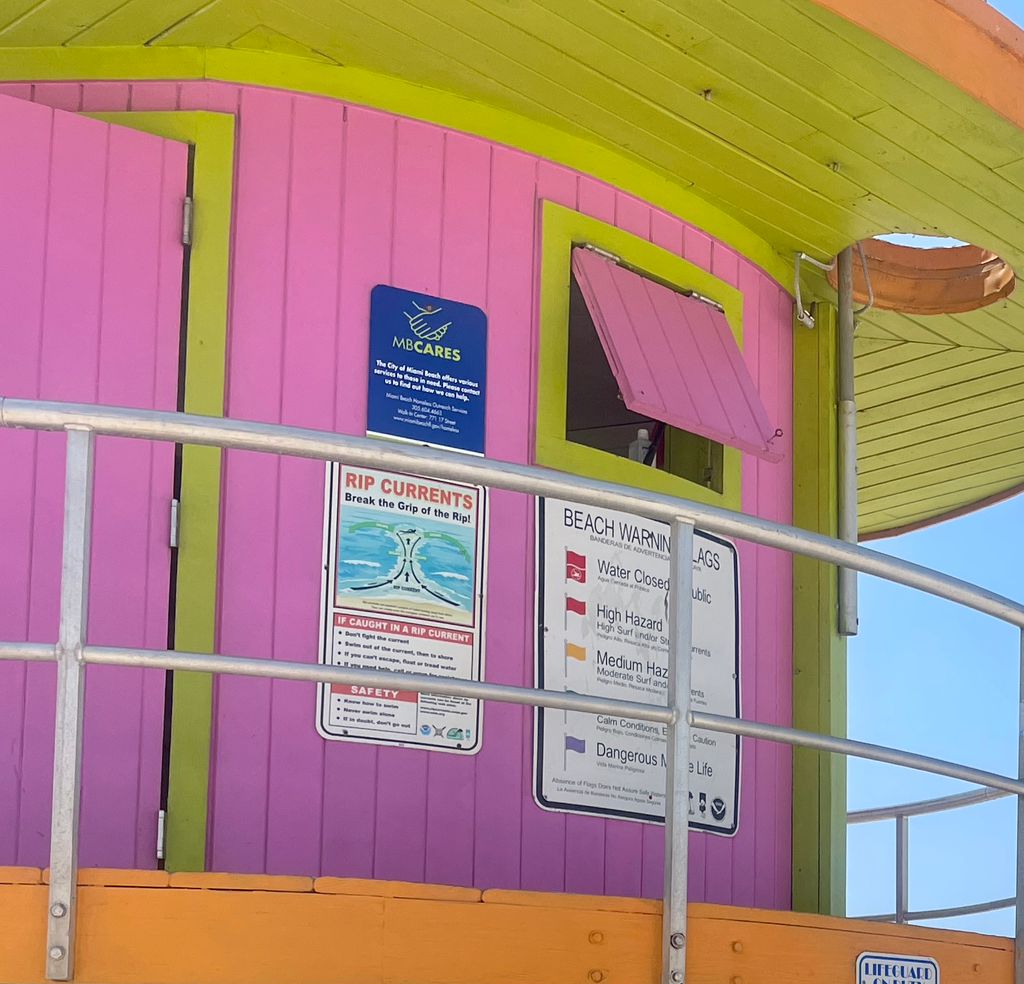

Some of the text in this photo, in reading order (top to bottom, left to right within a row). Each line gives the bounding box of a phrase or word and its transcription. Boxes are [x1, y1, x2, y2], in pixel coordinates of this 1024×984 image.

[392, 336, 461, 362] MBCARES
[376, 360, 386, 368] The
[387, 362, 398, 371] City
[406, 366, 423, 376] Miami
[425, 370, 440, 379] Beach
[345, 472, 473, 510] RIP CURRENTS
[345, 493, 471, 524] Break the Grip of the Rip!
[564, 508, 720, 570] BEACH WARNIN AGS
[590, 535, 622, 548] BANDERAS
[597, 558, 711, 604] Water Closed ublic
[337, 616, 469, 642] IF CAUGHT IN A RIP CURRENT
[597, 603, 663, 632] High Hazard
[597, 621, 615, 634] High
[617, 626, 634, 637] Surf
[597, 650, 668, 679] Medium Haz
[597, 666, 634, 682] Moderate
[636, 674, 651, 685] Surf
[351, 685, 399, 698] SAFETY
[597, 715, 618, 726] Calm
[620, 719, 660, 735] Conditions,
[692, 734, 716, 746] Caution
[596, 742, 657, 766] Dangerous
[697, 761, 713, 777] Life
[865, 962, 933, 980] LIFEGUARD
